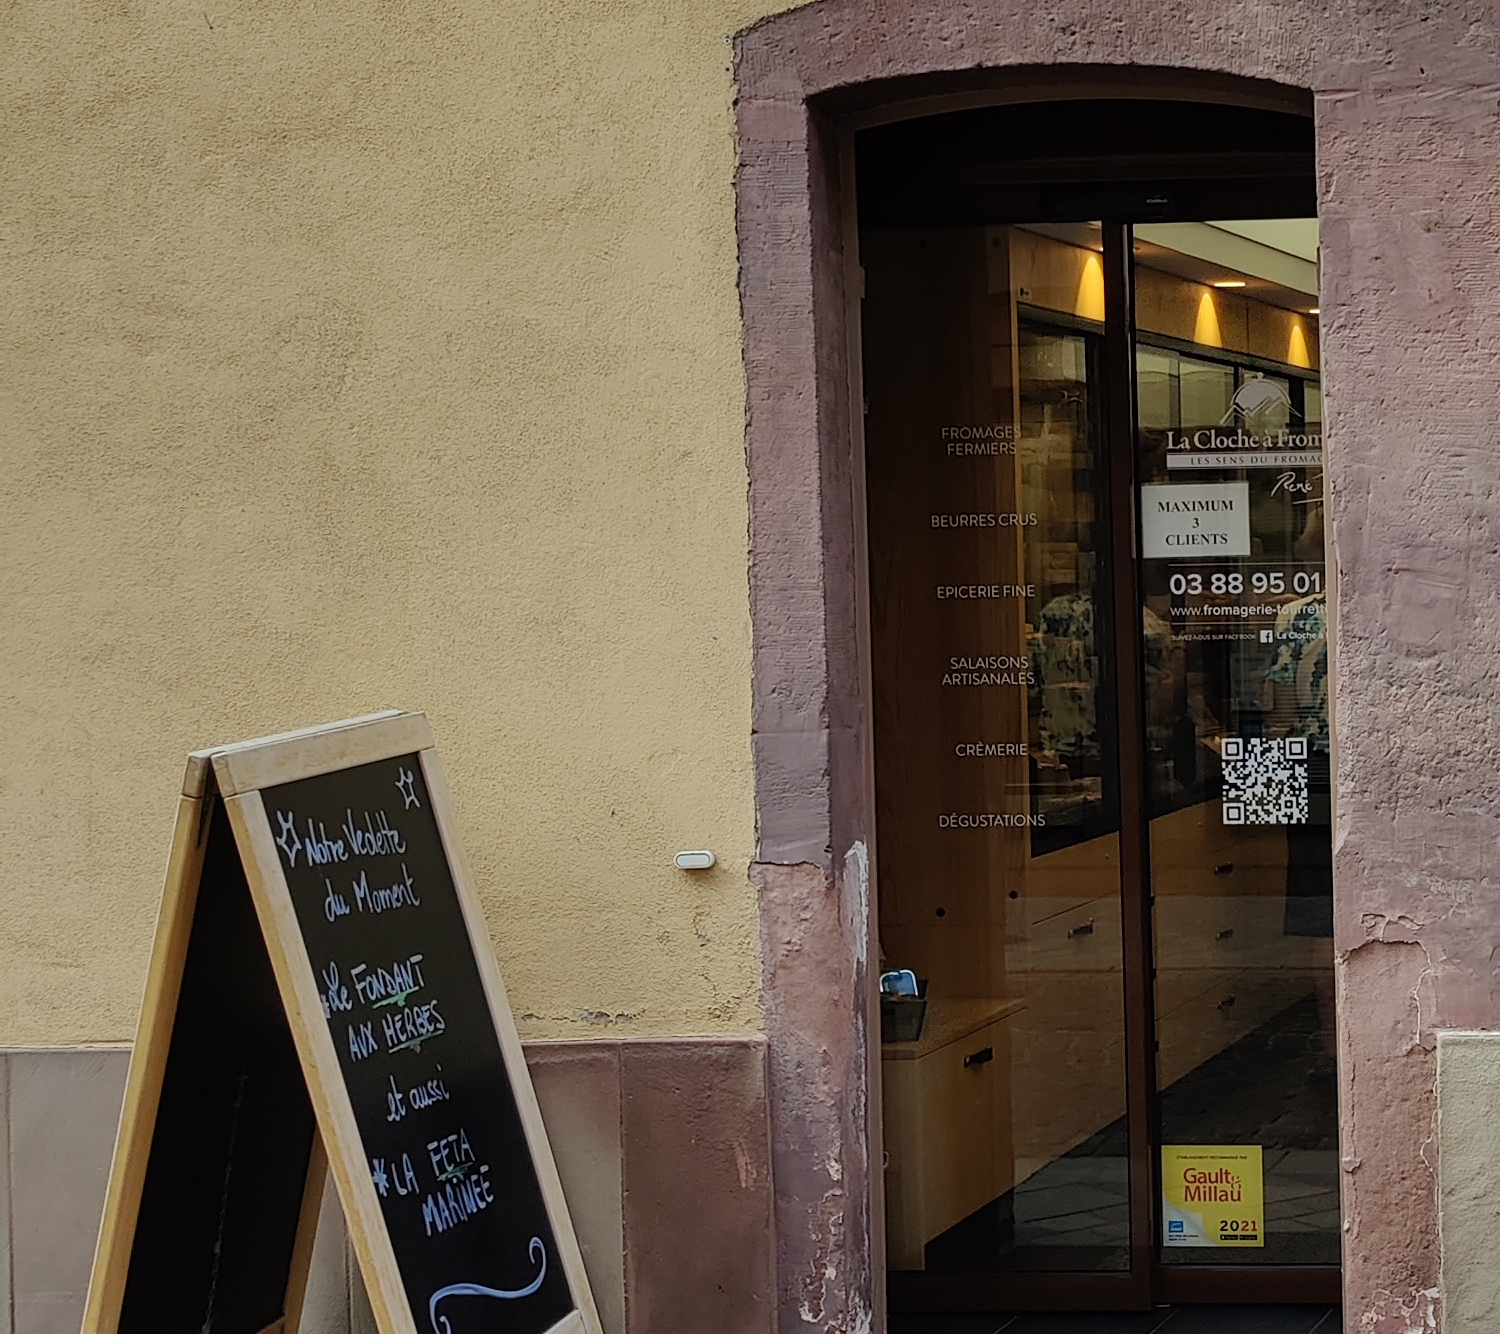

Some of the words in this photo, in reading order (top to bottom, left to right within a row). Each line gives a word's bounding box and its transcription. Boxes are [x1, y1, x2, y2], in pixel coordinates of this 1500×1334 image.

[941, 426, 1021, 440] FROMAGES
[1166, 430, 1190, 450] La
[1194, 428, 1258, 449] Cloche
[1262, 429, 1273, 447] à
[947, 441, 1017, 456] FERMIERS
[1190, 456, 1210, 465] LES
[1216, 455, 1244, 465] SENS
[1251, 455, 1268, 464] DU
[1158, 500, 1234, 513] MAXIMUM
[931, 513, 996, 527] BEURRES
[998, 513, 1038, 526] CRUS
[1192, 517, 1200, 529] 3
[1165, 533, 1228, 546] CLIENTS
[1169, 573, 1202, 595] 03
[1211, 573, 1244, 595] 88
[1251, 572, 1285, 594] 95
[1293, 572, 1321, 593] 01
[937, 585, 1000, 599] EPICERIE
[1003, 584, 1035, 597] FINE
[1288, 631, 1317, 640] Cloche
[950, 656, 1029, 670] SALAISONS
[941, 671, 1035, 686] ARTISANALES
[955, 741, 1028, 757] CRÈMERIE
[939, 812, 1046, 828] DÉGUSTATIONS
[304, 818, 349, 867] Notre
[342, 808, 406, 855] Vedette
[325, 878, 350, 923] du
[352, 862, 421, 914] Moment
[351, 954, 425, 1005] FONDANT
[382, 999, 446, 1048] HERBES
[387, 1075, 406, 1122] et
[409, 1063, 450, 1110] aussi
[426, 1127, 476, 1177] FETA
[1183, 1167, 1231, 1185] Gault
[1184, 1185, 1242, 1202] Millau
[1220, 1220, 1258, 1232] 2021
